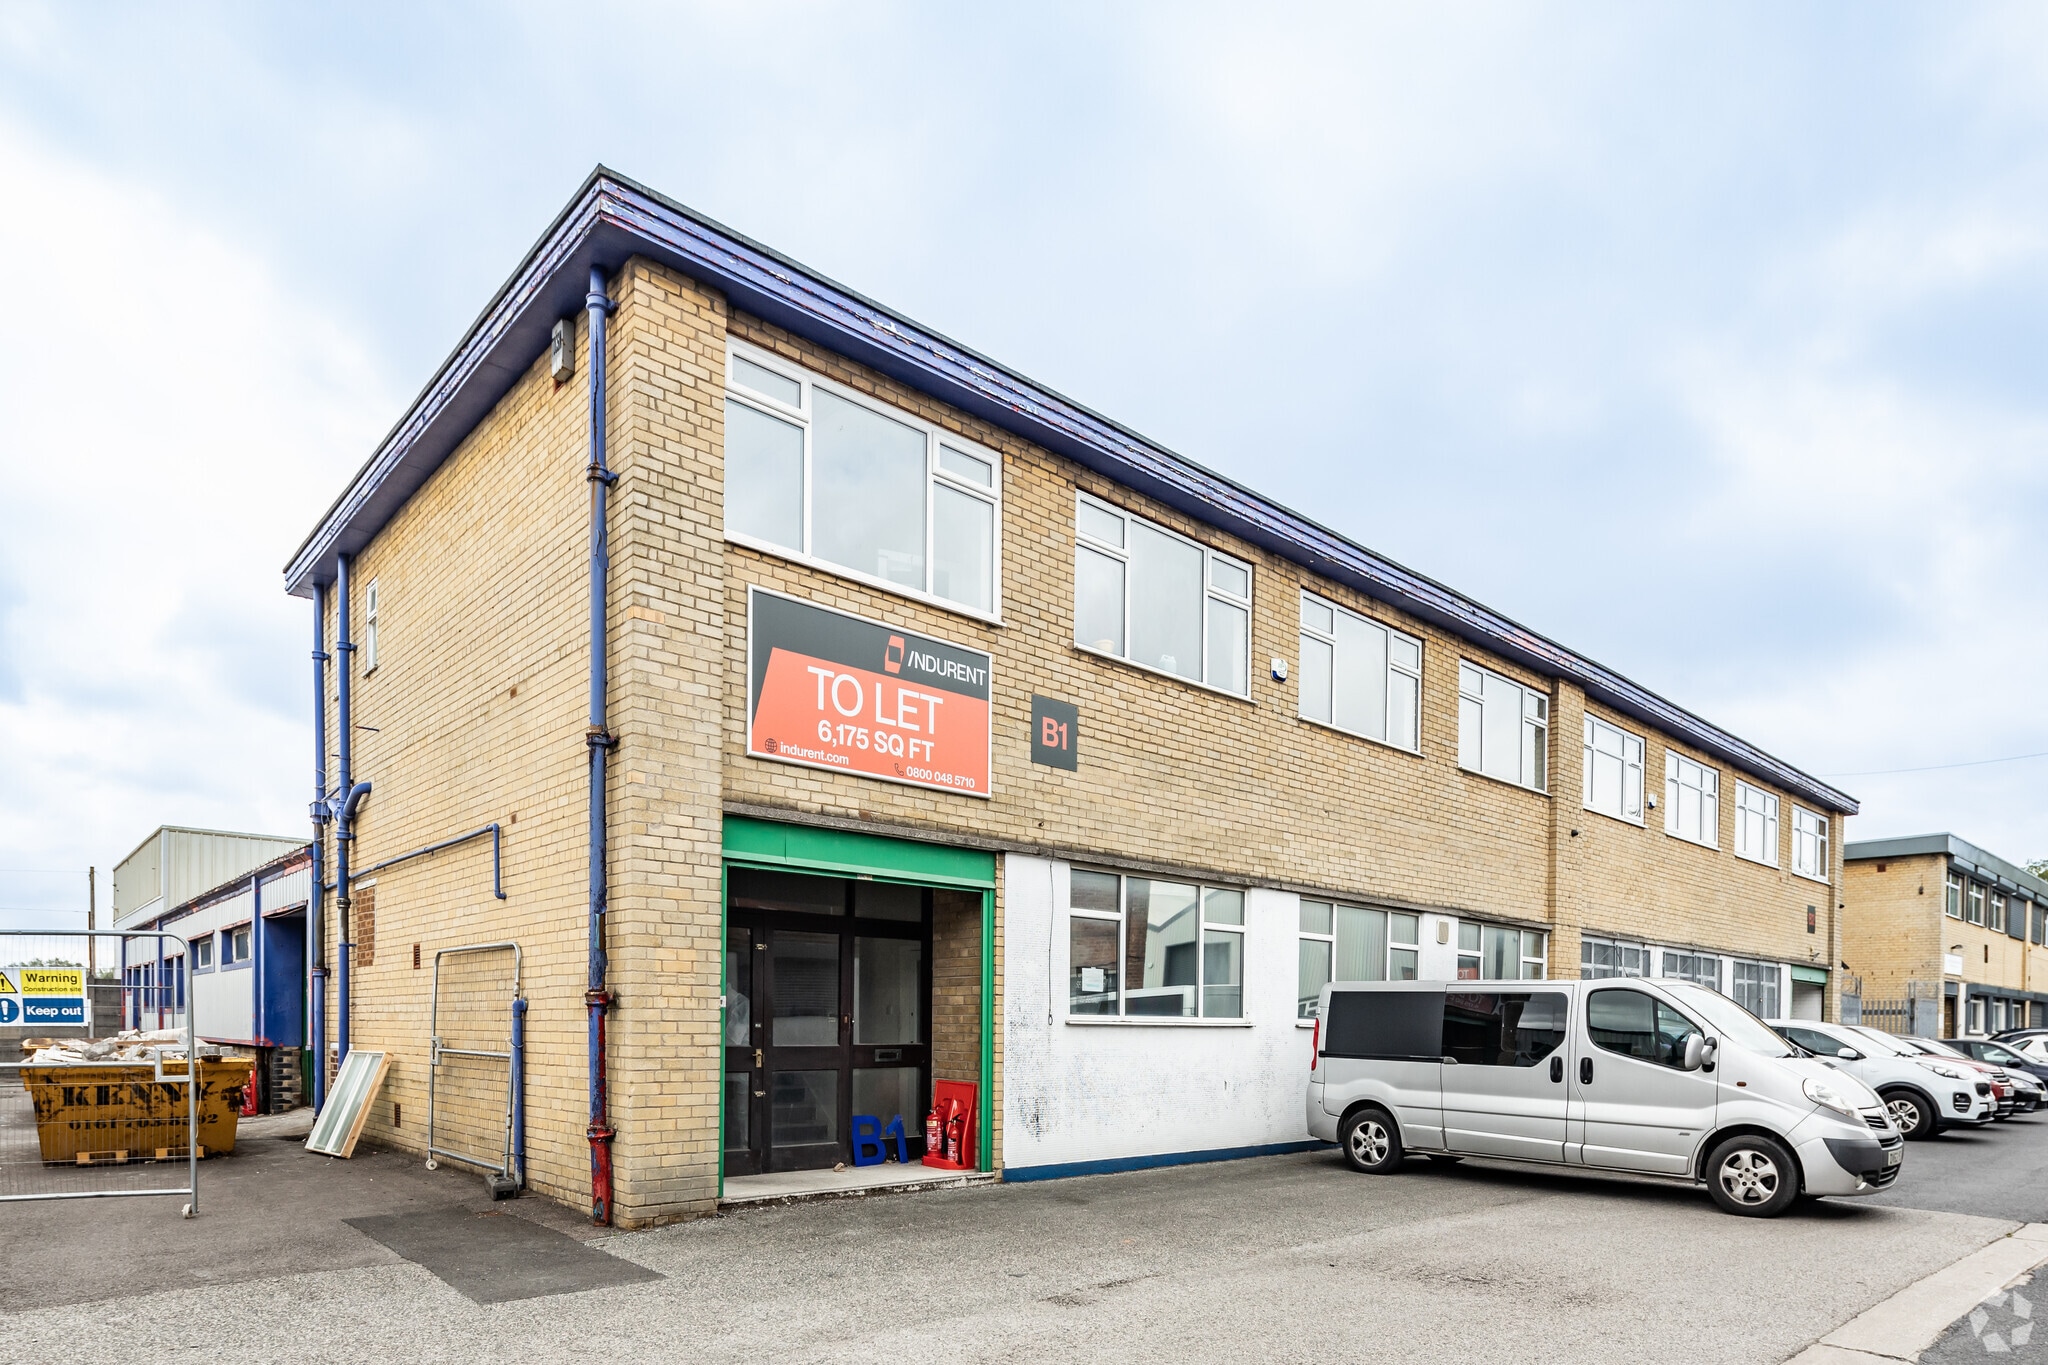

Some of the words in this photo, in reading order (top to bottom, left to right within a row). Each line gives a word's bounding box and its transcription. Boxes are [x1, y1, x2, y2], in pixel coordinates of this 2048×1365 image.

[807, 665, 864, 717] TO
[875, 682, 944, 735] LET
[817, 719, 870, 750] 6,175
[873, 730, 905, 758] SQ
[909, 737, 935, 762] FT
[1042, 716, 1068, 751] B1
[780, 741, 849, 765] indurent.com
[906, 766, 933, 781] 0800
[934, 771, 953, 784] 048
[954, 775, 975, 788] 5710
[25, 973, 78, 985] Warning
[26, 1005, 59, 1018] Keep
[61, 1006, 82, 1016] out
[852, 1114, 909, 1167] B1
